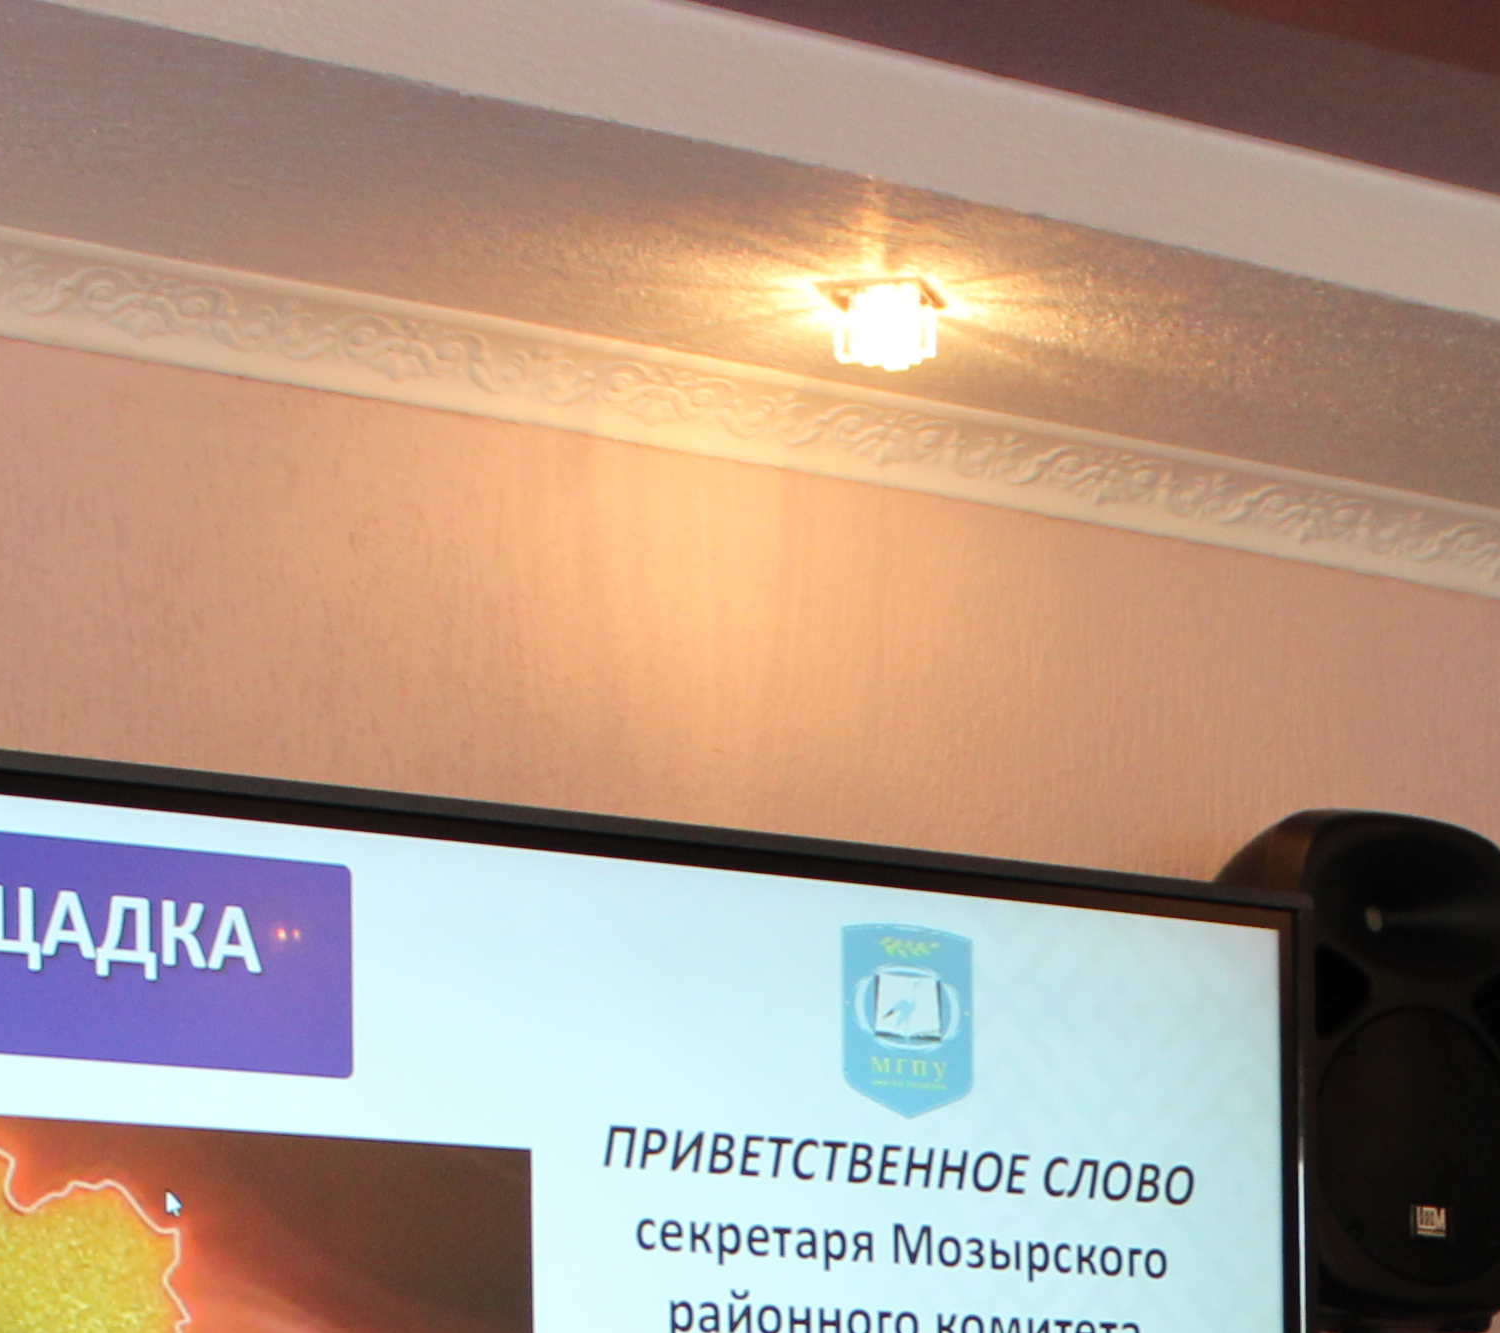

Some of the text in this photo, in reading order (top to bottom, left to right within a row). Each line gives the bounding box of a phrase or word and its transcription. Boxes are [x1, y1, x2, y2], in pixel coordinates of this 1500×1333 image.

[603, 1125, 1197, 1206] ПРИВЕТСТВЕННОЕ СЛОВО
[636, 1217, 1169, 1282] секретаря Мозырского
